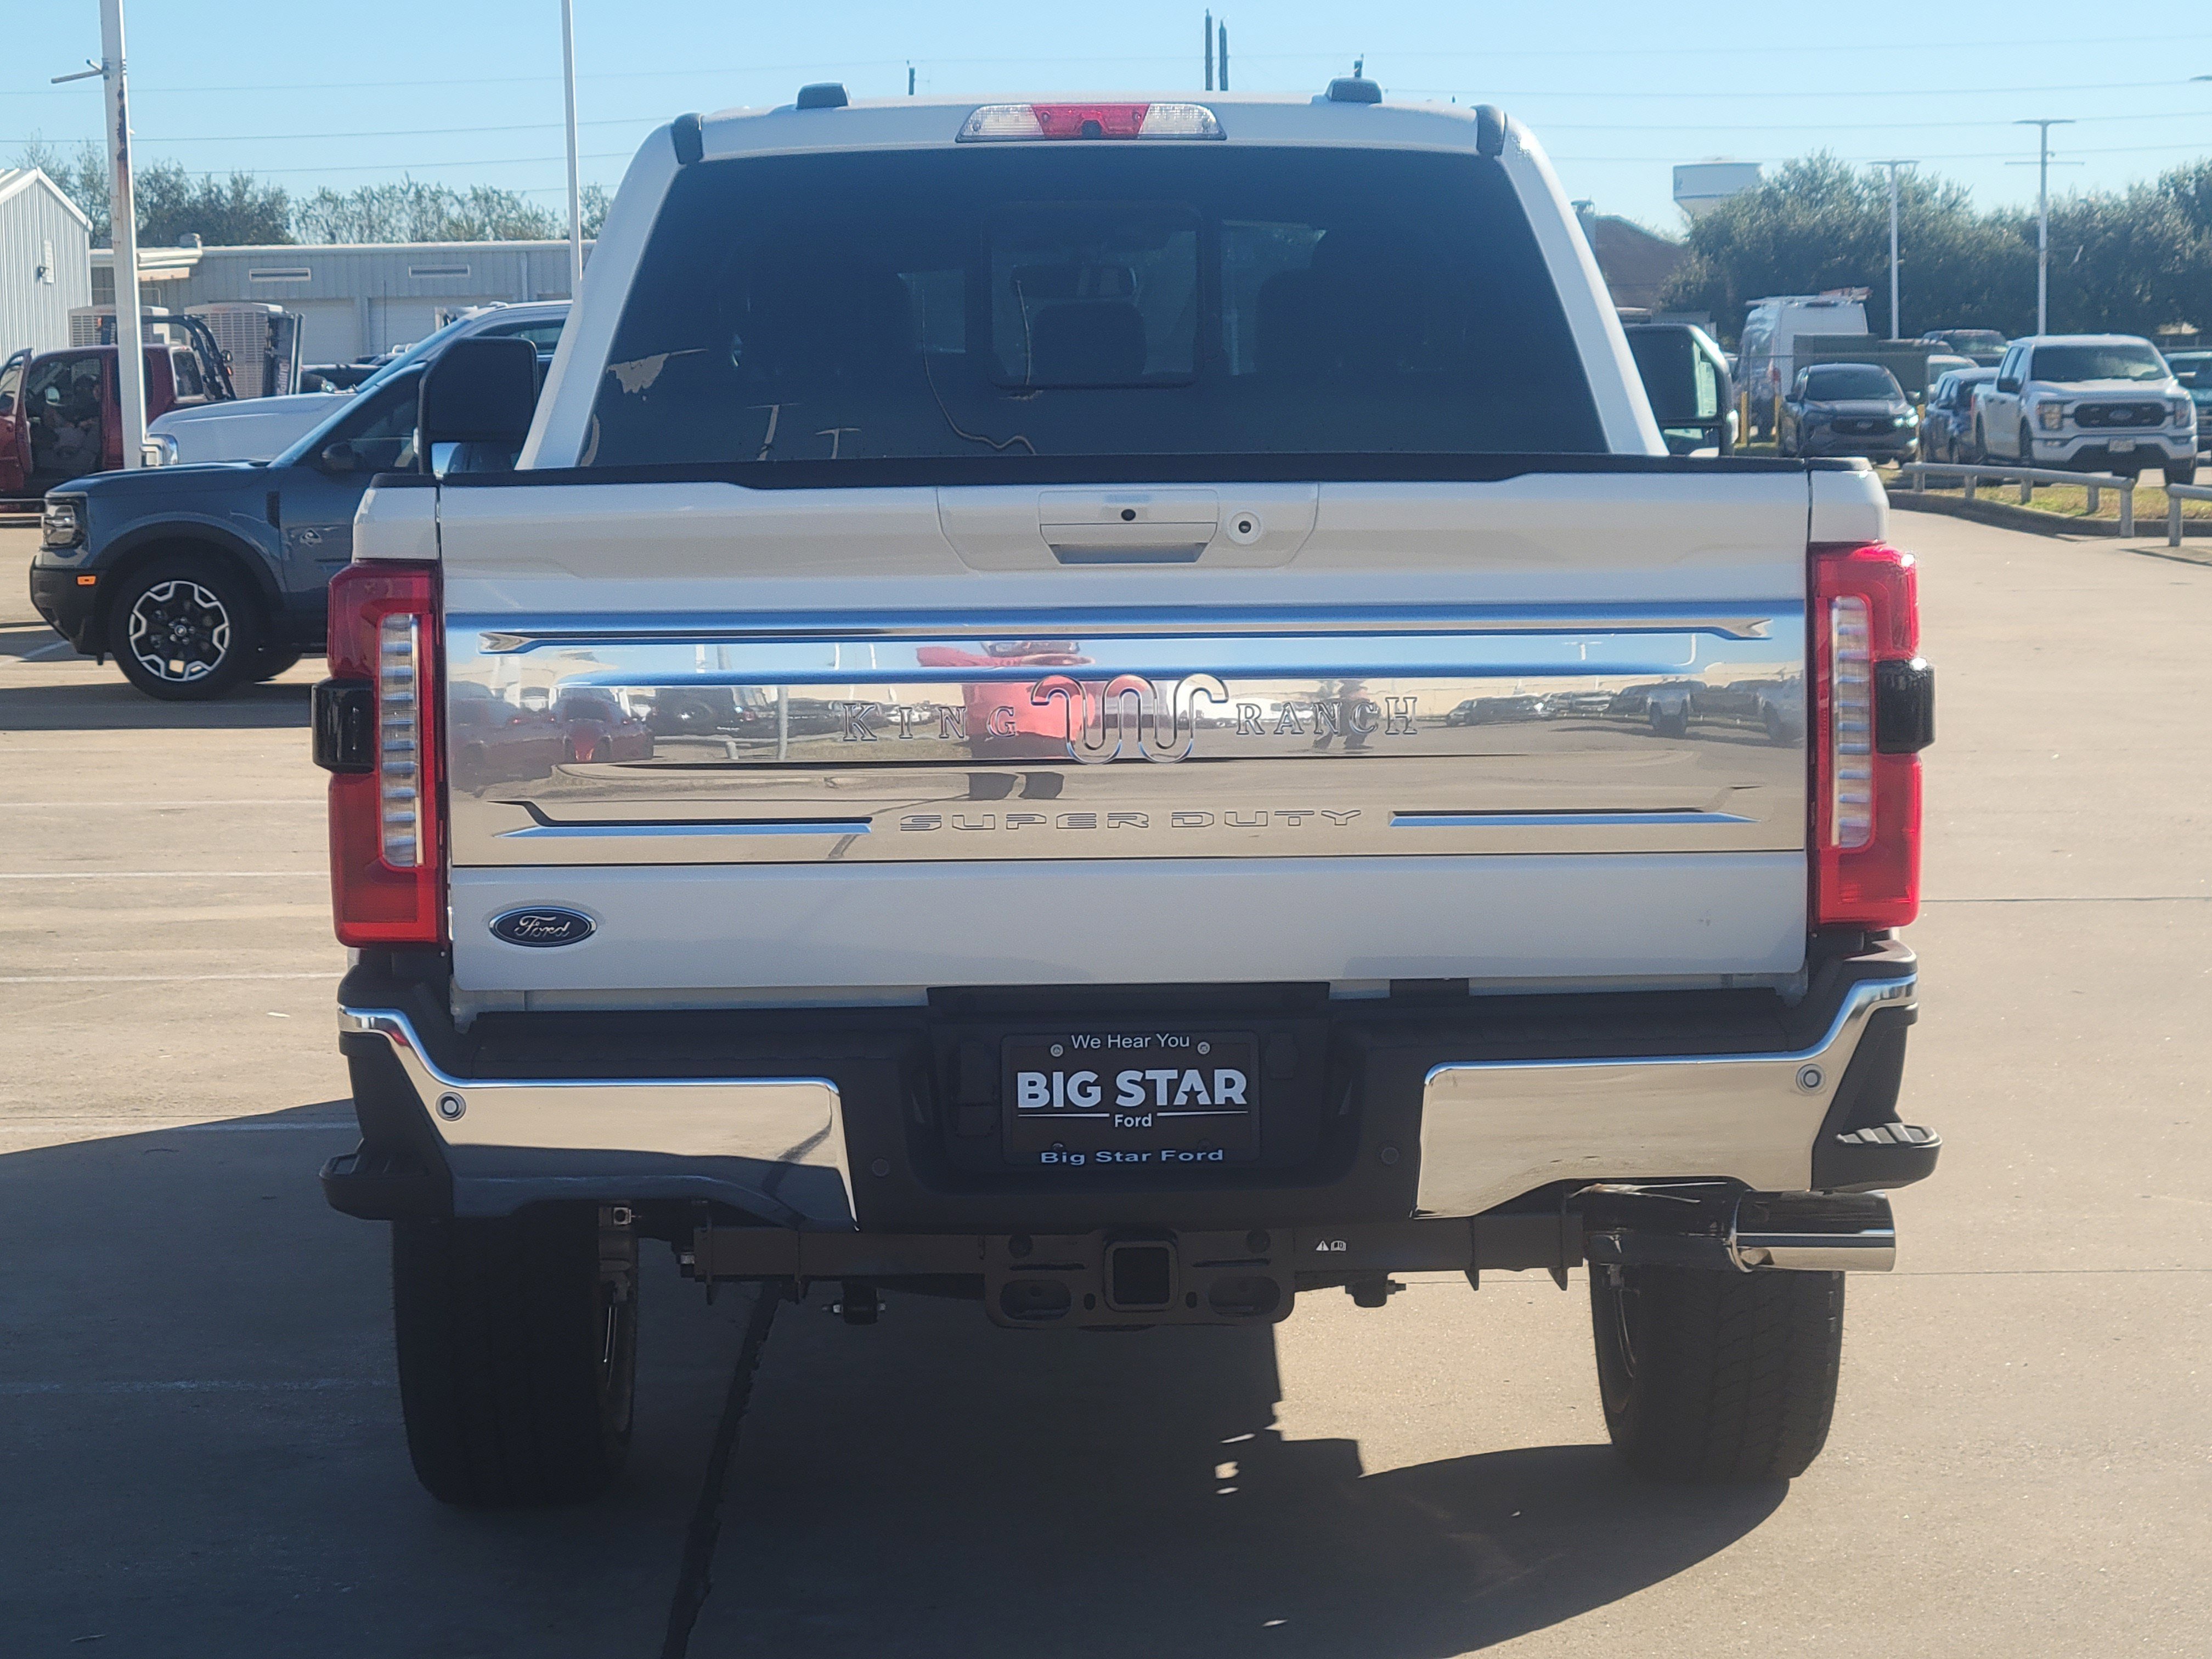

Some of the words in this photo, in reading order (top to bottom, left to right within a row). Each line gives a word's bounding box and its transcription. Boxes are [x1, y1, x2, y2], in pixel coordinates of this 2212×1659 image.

[843, 702, 1016, 741] KING
[1235, 696, 1418, 736] RANCH
[900, 812, 1150, 831] SUPER
[1171, 809, 1362, 829] DUTY
[514, 915, 571, 938] Ford
[1071, 1035, 1101, 1049] We
[1107, 1034, 1151, 1048] Hear
[1156, 1034, 1190, 1047] You
[1017, 1071, 1102, 1108] BIG
[1115, 1069, 1247, 1106] STAR
[1115, 1114, 1152, 1127] Ford
[1041, 1151, 1085, 1165] Big
[1096, 1150, 1152, 1163] Star
[1161, 1149, 1223, 1161] Ford
